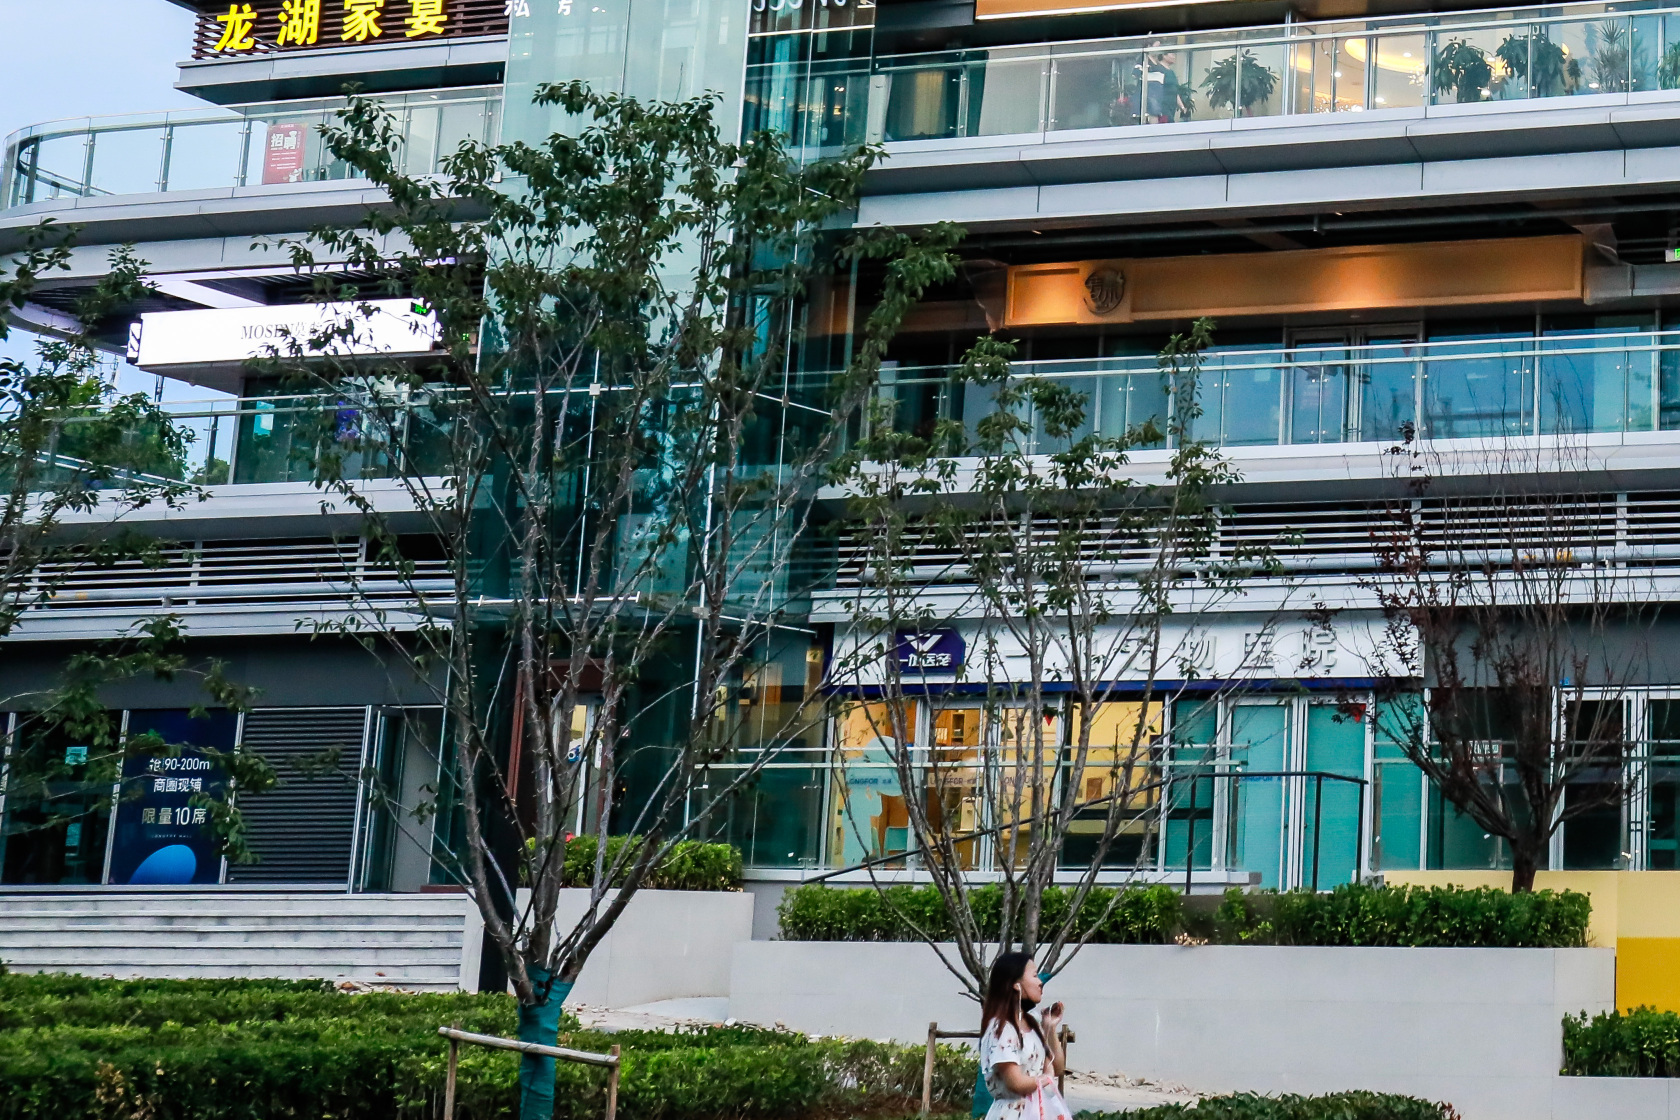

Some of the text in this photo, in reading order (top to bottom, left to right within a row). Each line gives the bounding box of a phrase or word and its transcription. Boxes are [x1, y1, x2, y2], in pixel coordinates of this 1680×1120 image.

[153, 778, 202, 792] 商圈现铺
[141, 807, 207, 825] 限量10席
